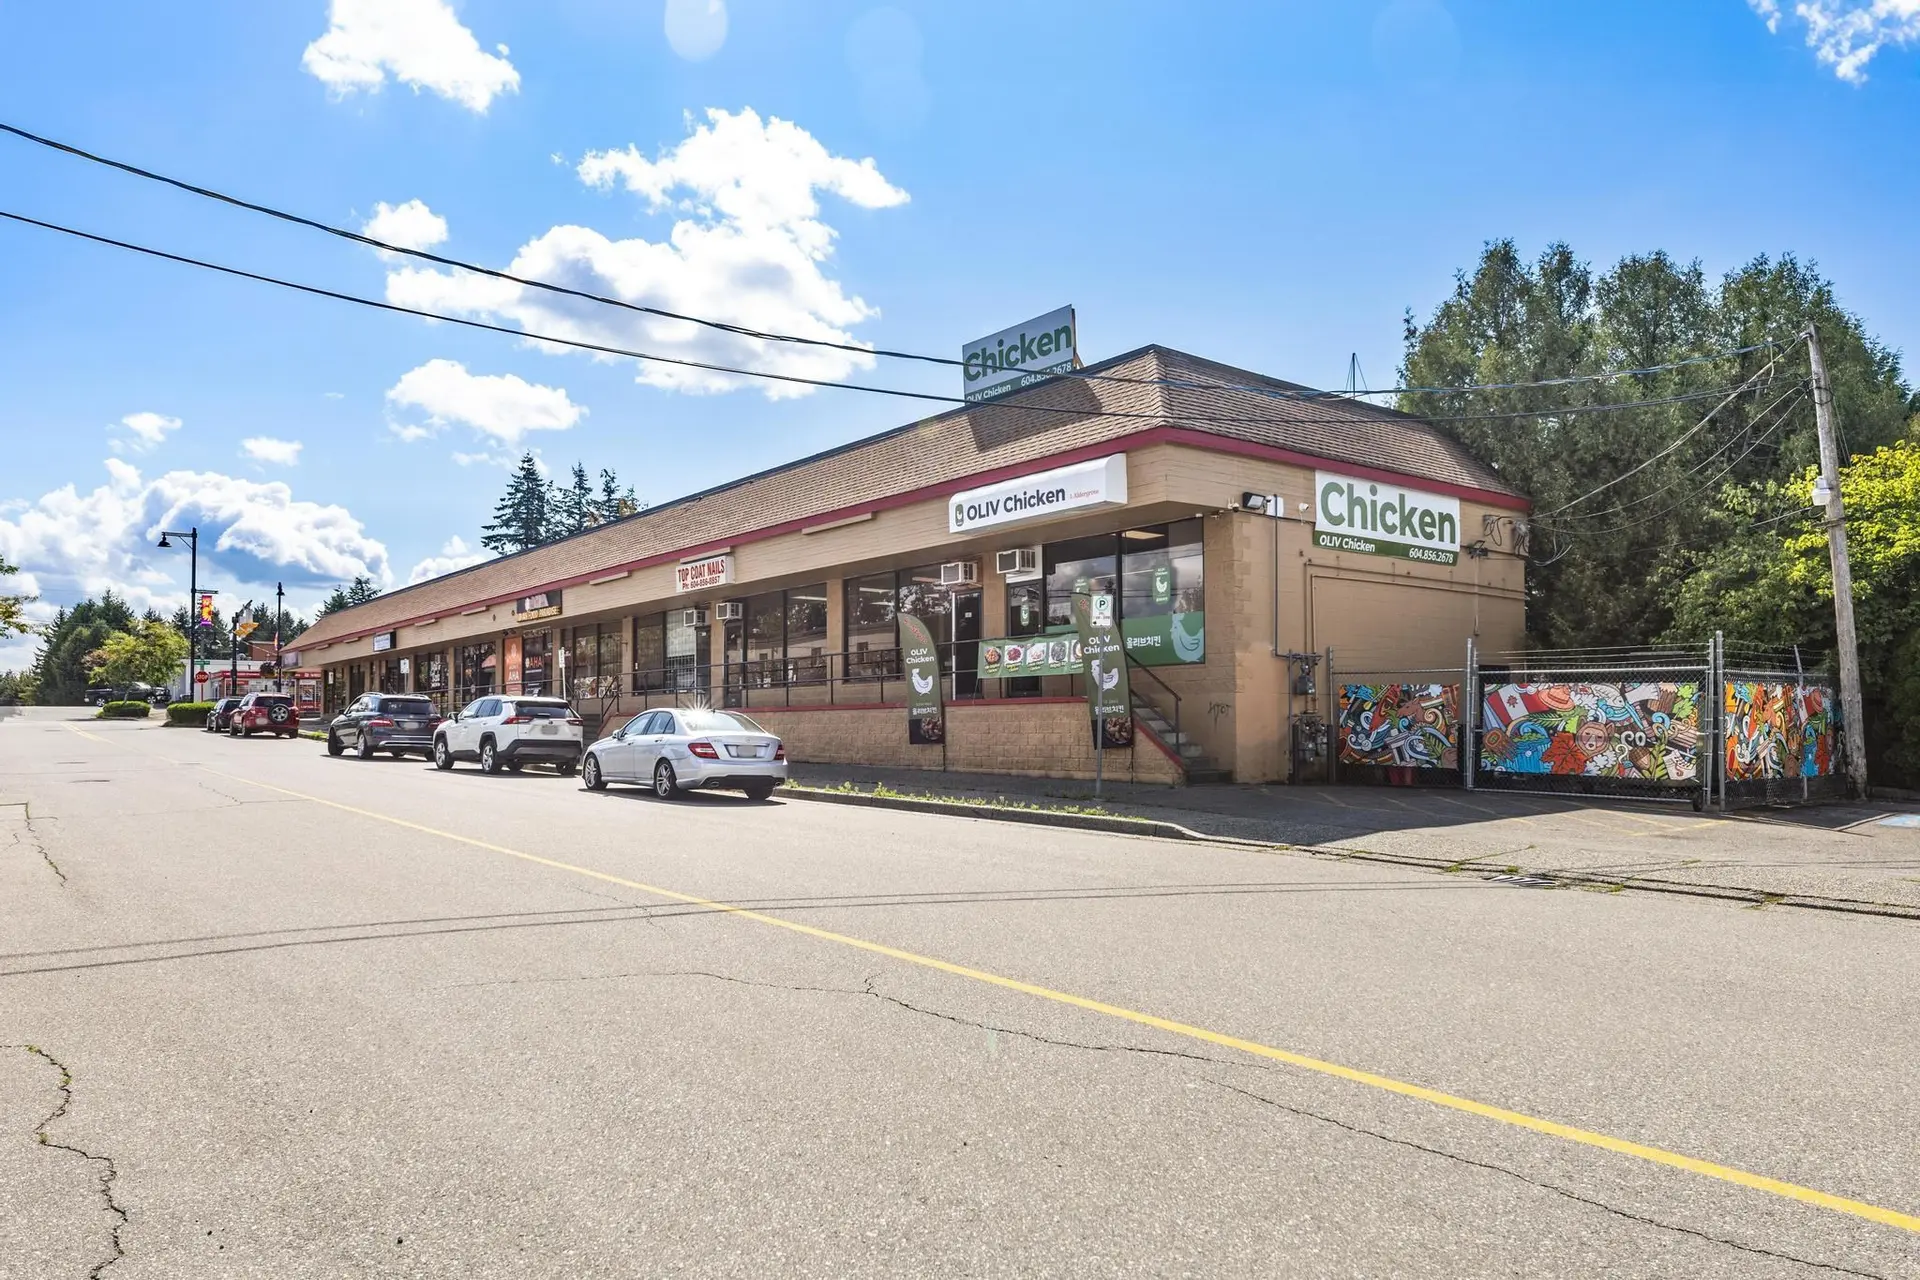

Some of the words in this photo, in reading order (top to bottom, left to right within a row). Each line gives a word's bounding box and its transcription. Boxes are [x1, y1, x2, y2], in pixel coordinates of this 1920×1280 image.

[963, 325, 1072, 382] Chicken
[983, 384, 1011, 399] Chicken
[966, 499, 1001, 521] OLIV
[1003, 487, 1066, 513] Chicken
[1320, 481, 1456, 545] Chicken
[1319, 534, 1342, 547] OLIV
[1342, 537, 1376, 553] Chicken
[1408, 547, 1454, 564] 604.856.2678
[677, 567, 689, 582] TOP
[690, 563, 706, 580] COAT
[707, 559, 725, 576] NAILS
[1099, 600, 1106, 608] P
[1088, 635, 1111, 645] OLV
[1126, 635, 1161, 649] 올리브치킨
[910, 647, 928, 656] OLIV
[906, 655, 935, 664] Chicken
